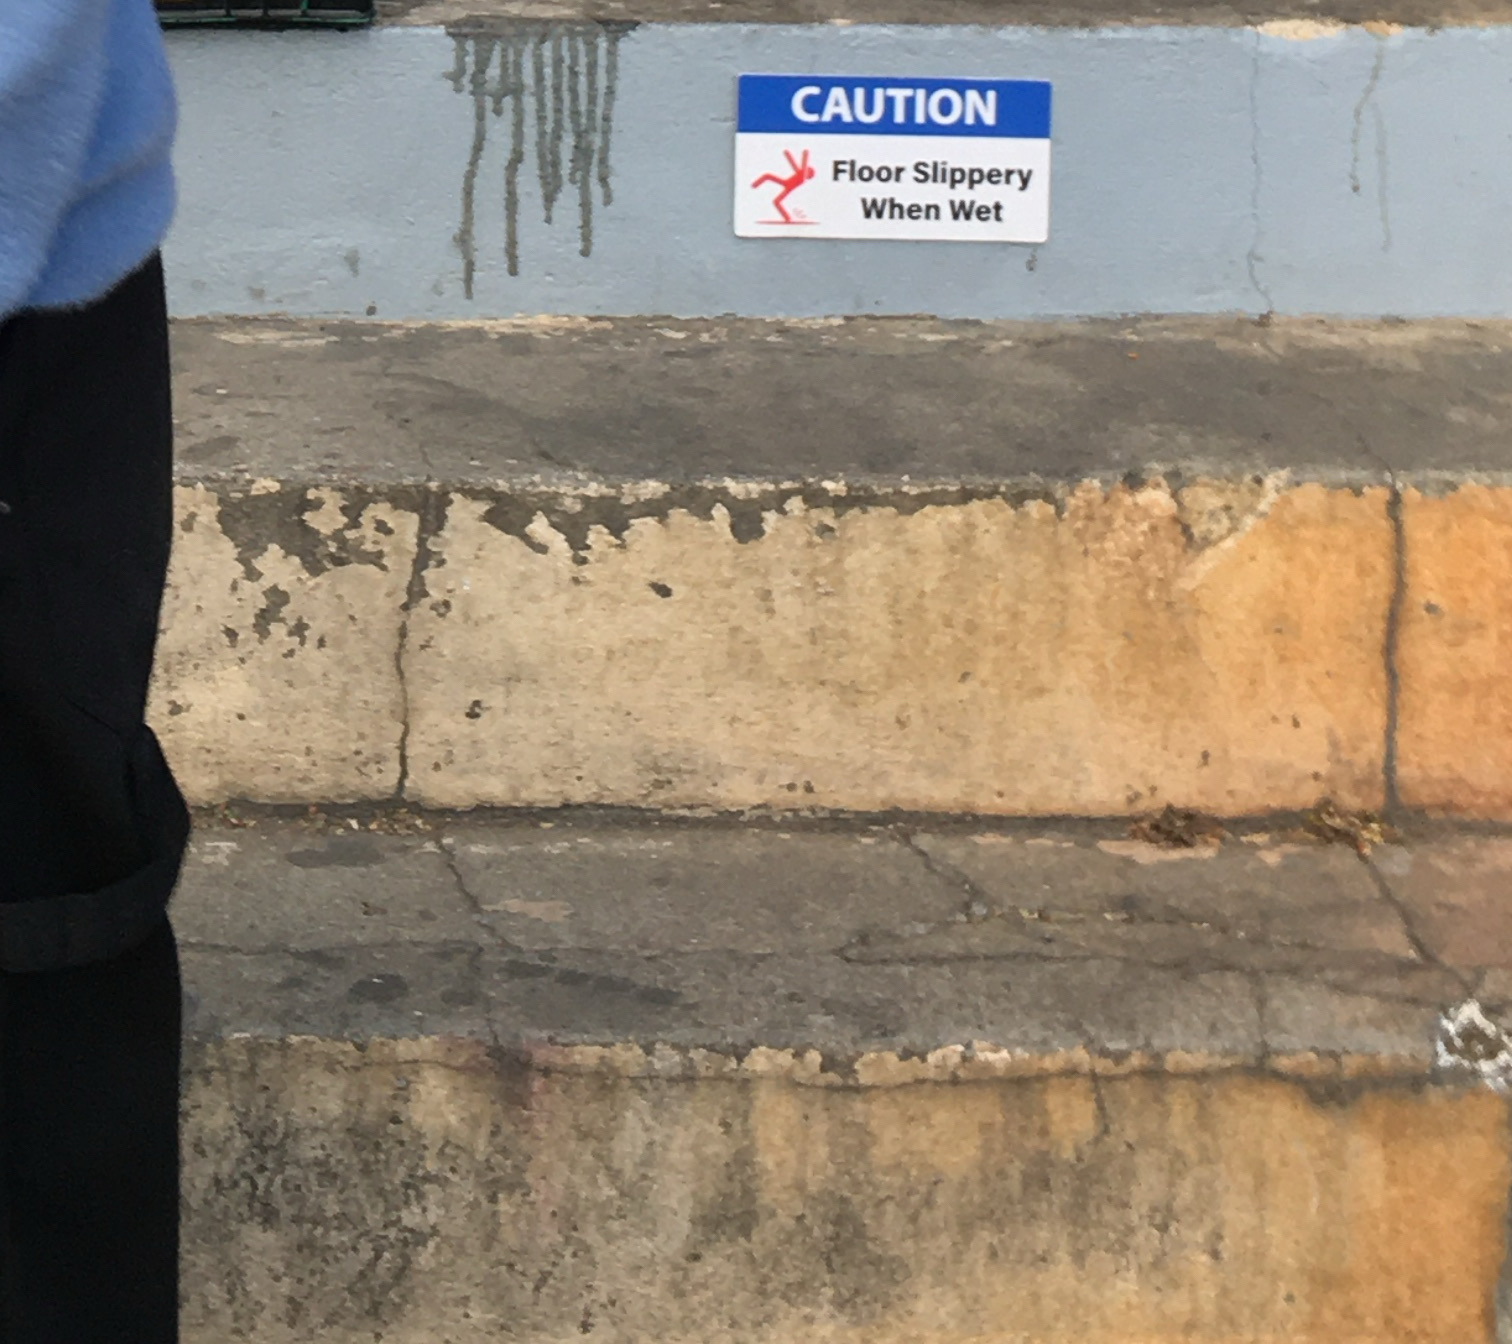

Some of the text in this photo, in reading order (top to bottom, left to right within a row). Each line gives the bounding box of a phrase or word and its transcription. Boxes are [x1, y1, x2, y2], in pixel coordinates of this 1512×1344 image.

[791, 85, 997, 125] CAUTION
[833, 160, 1032, 191] Floor Slippery
[861, 197, 1003, 222] When Wet
